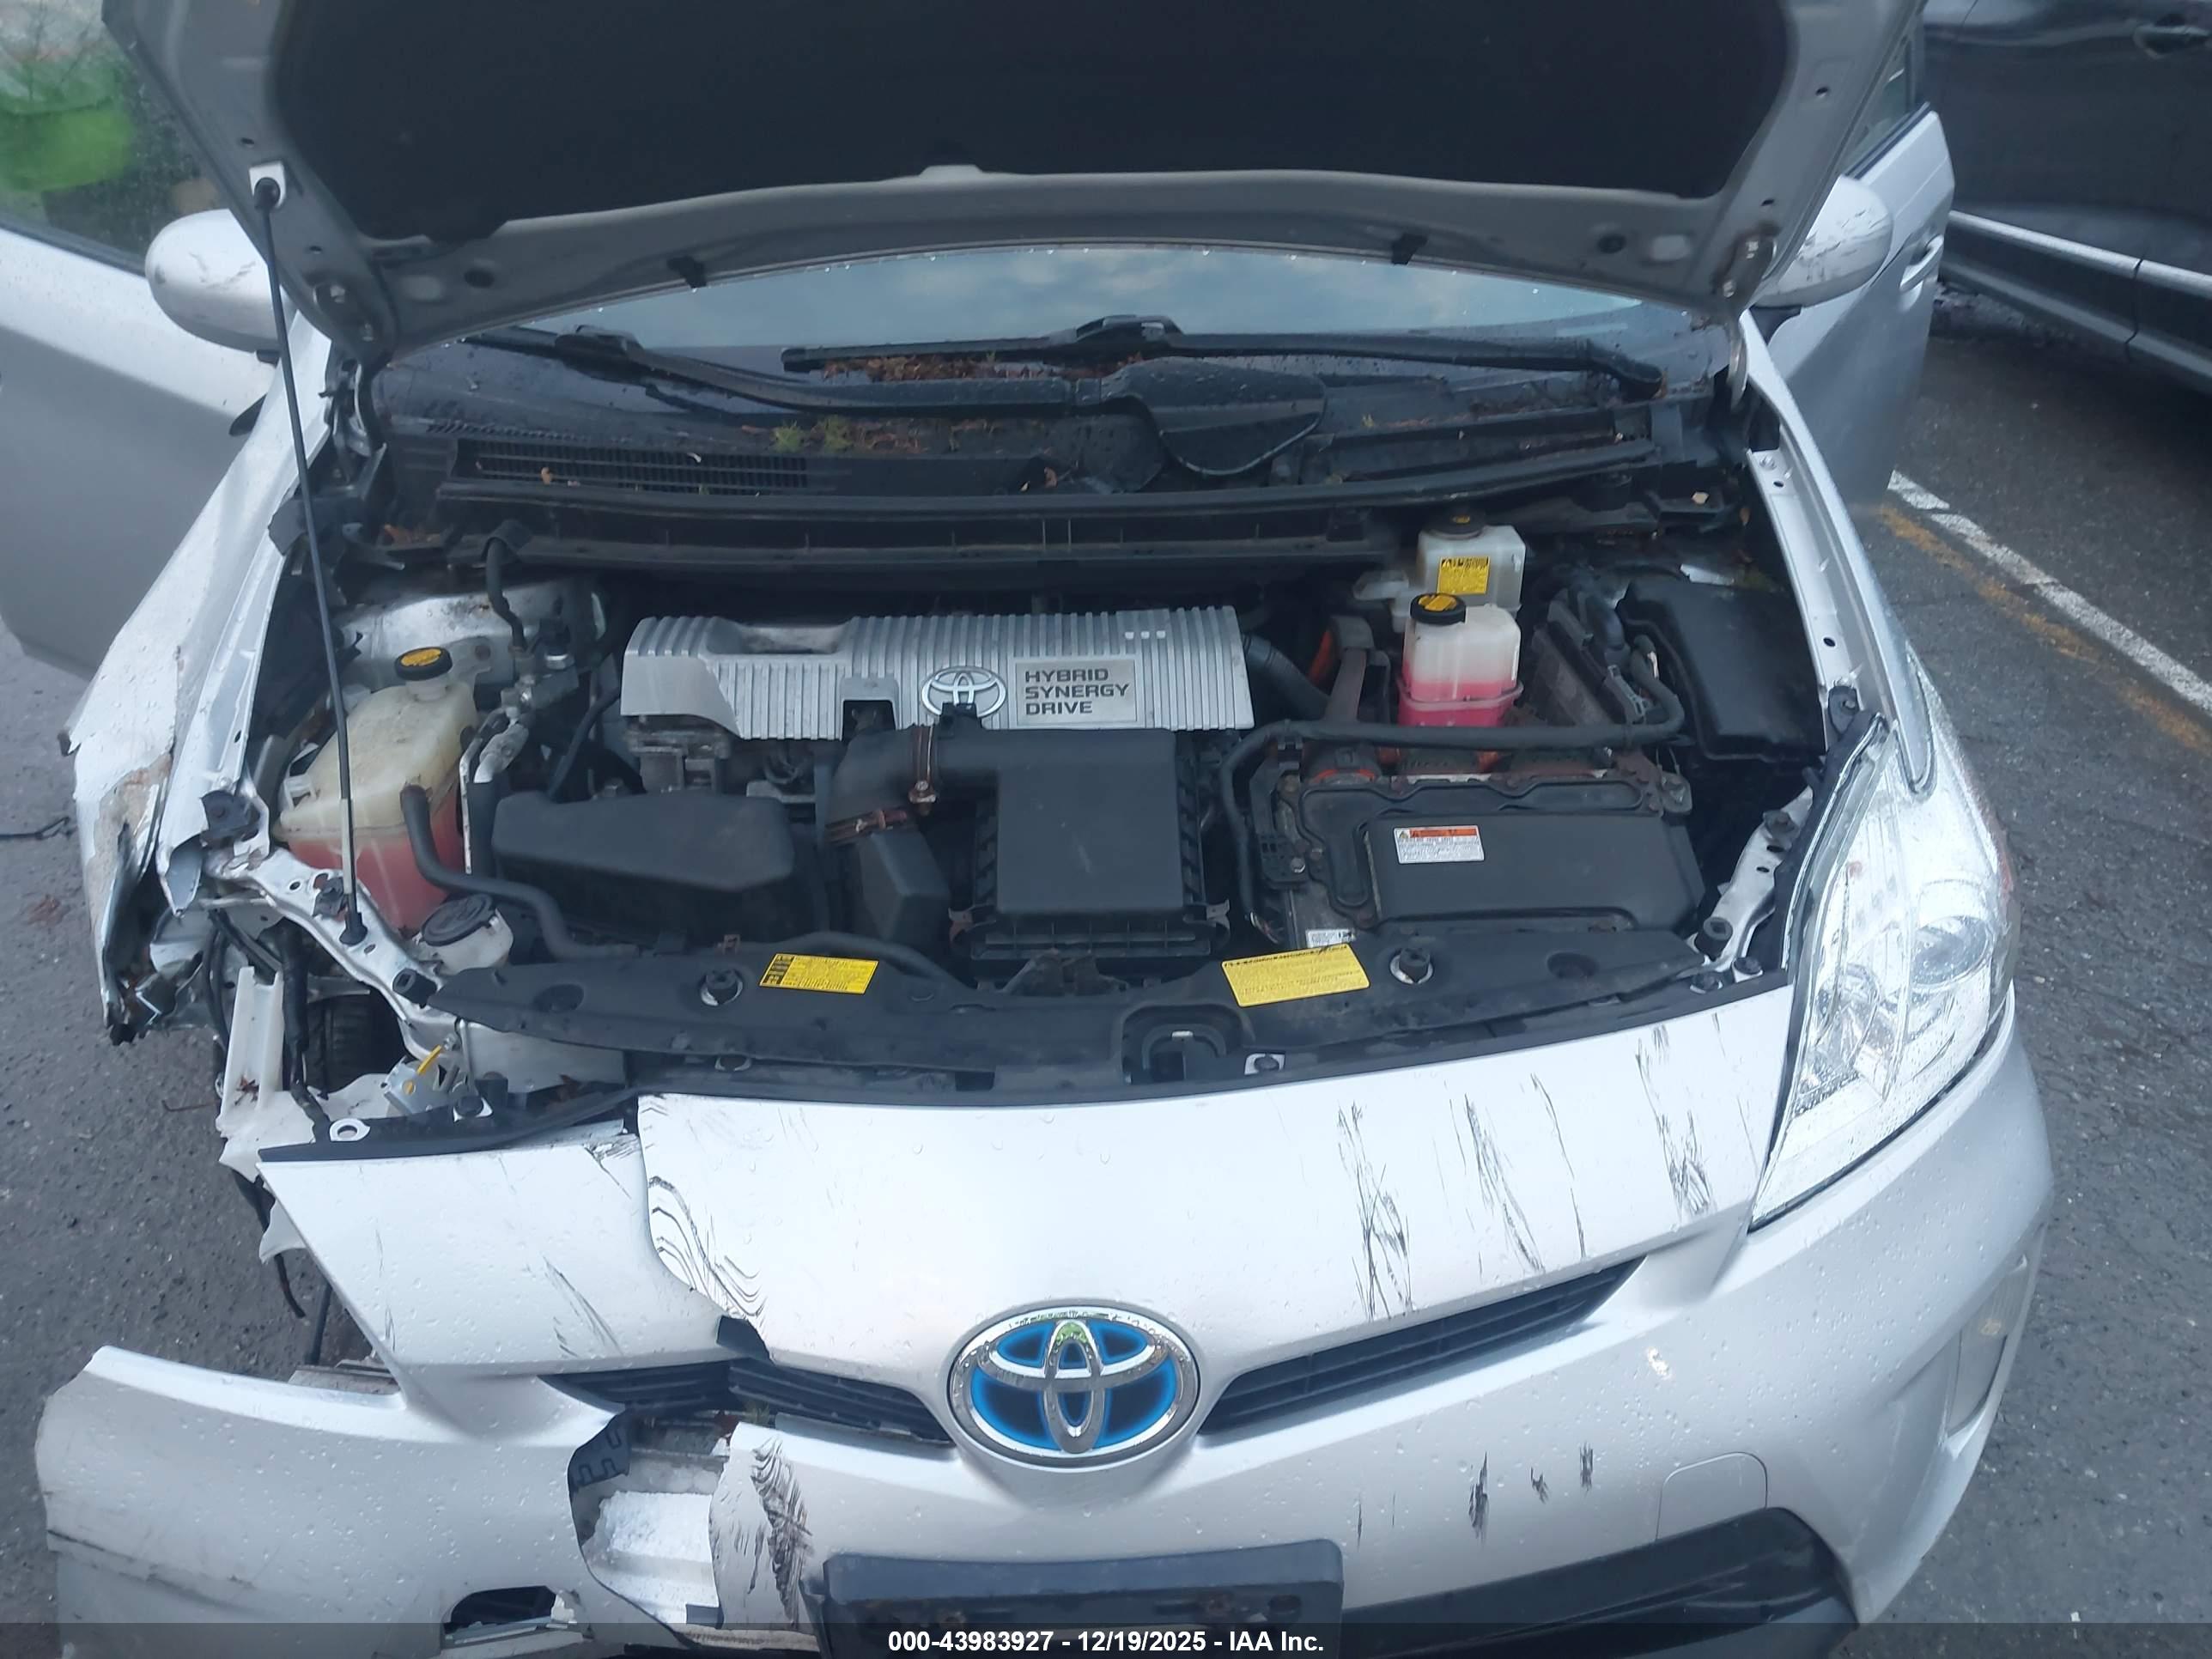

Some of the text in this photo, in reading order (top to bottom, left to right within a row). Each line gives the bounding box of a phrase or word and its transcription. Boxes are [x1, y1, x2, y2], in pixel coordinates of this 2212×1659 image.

[1025, 669, 1109, 683] HYBRID
[1025, 684, 1129, 700] SYNERGY
[1025, 701, 1093, 715] DRIVE
